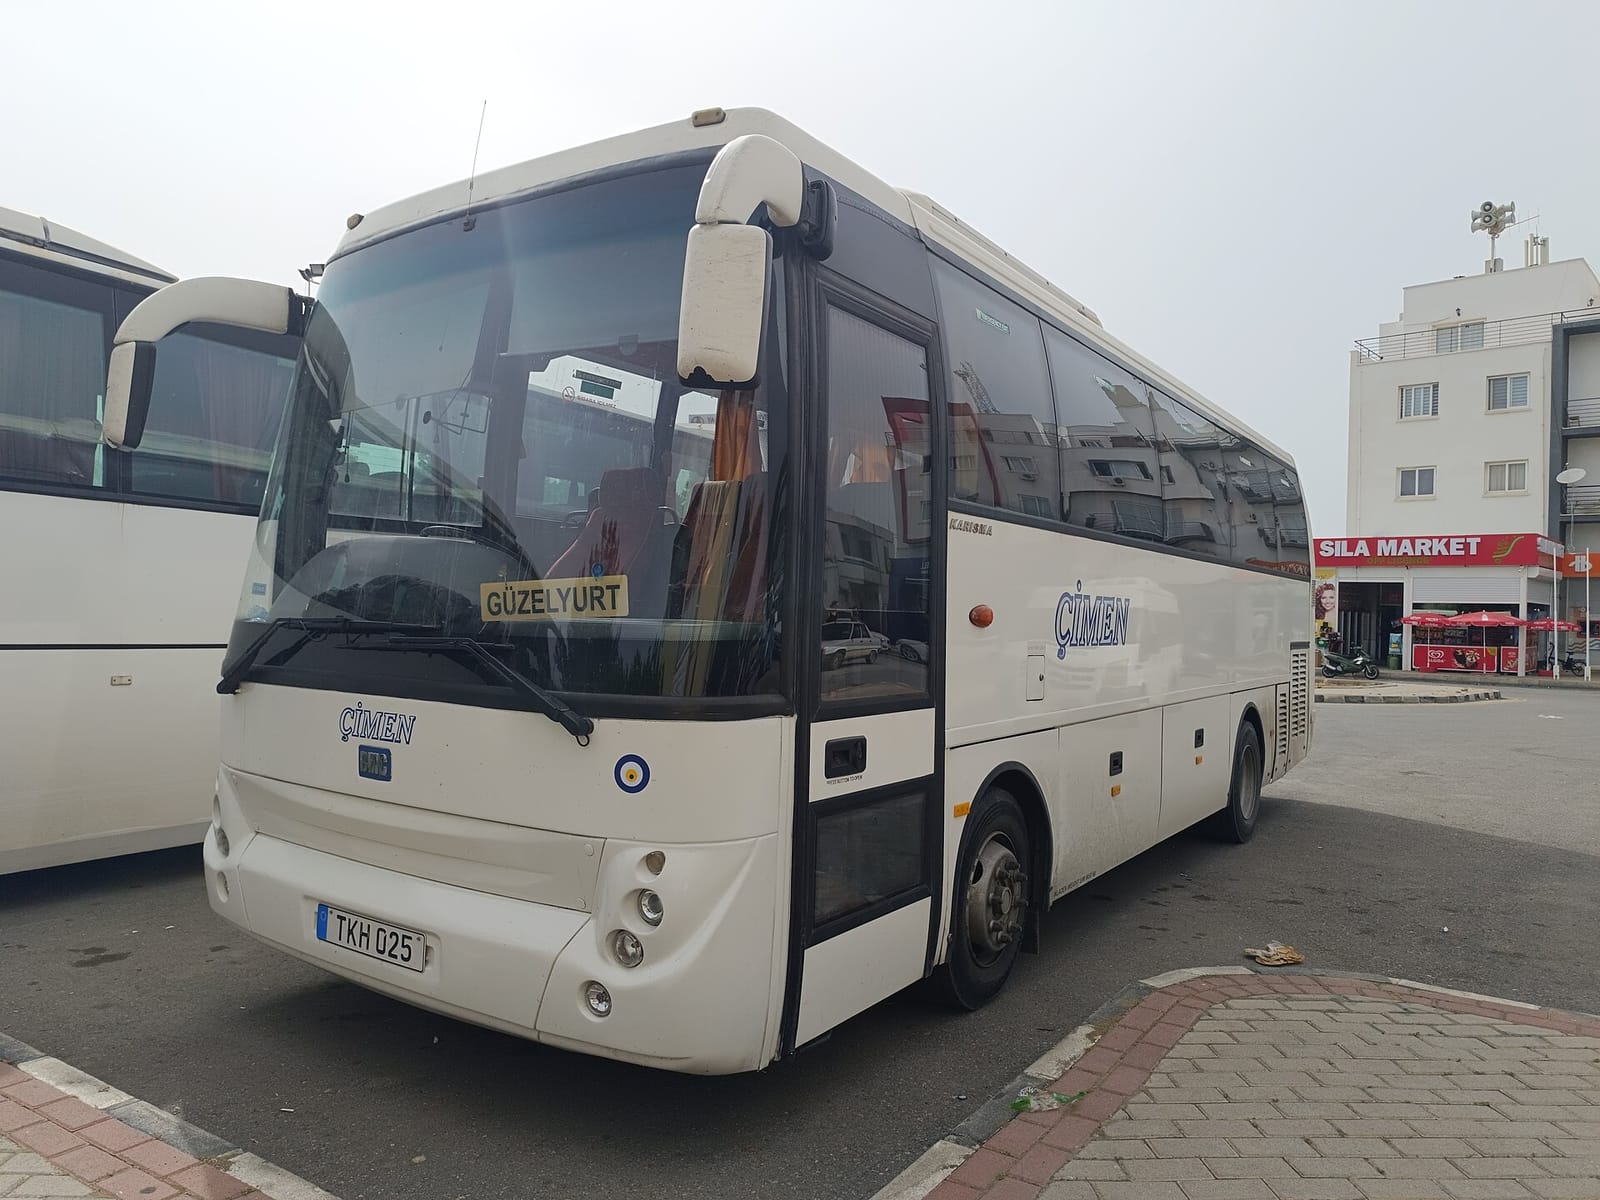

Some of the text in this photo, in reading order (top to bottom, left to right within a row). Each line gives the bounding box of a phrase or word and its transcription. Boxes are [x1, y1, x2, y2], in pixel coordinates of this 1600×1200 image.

[1319, 537, 1481, 557] SILA MARKET
[486, 584, 621, 616] GÜZELYURT
[1054, 579, 1131, 660] ÇİMEN
[338, 701, 417, 745] ÇİMEN
[336, 914, 413, 962] TKH 025
